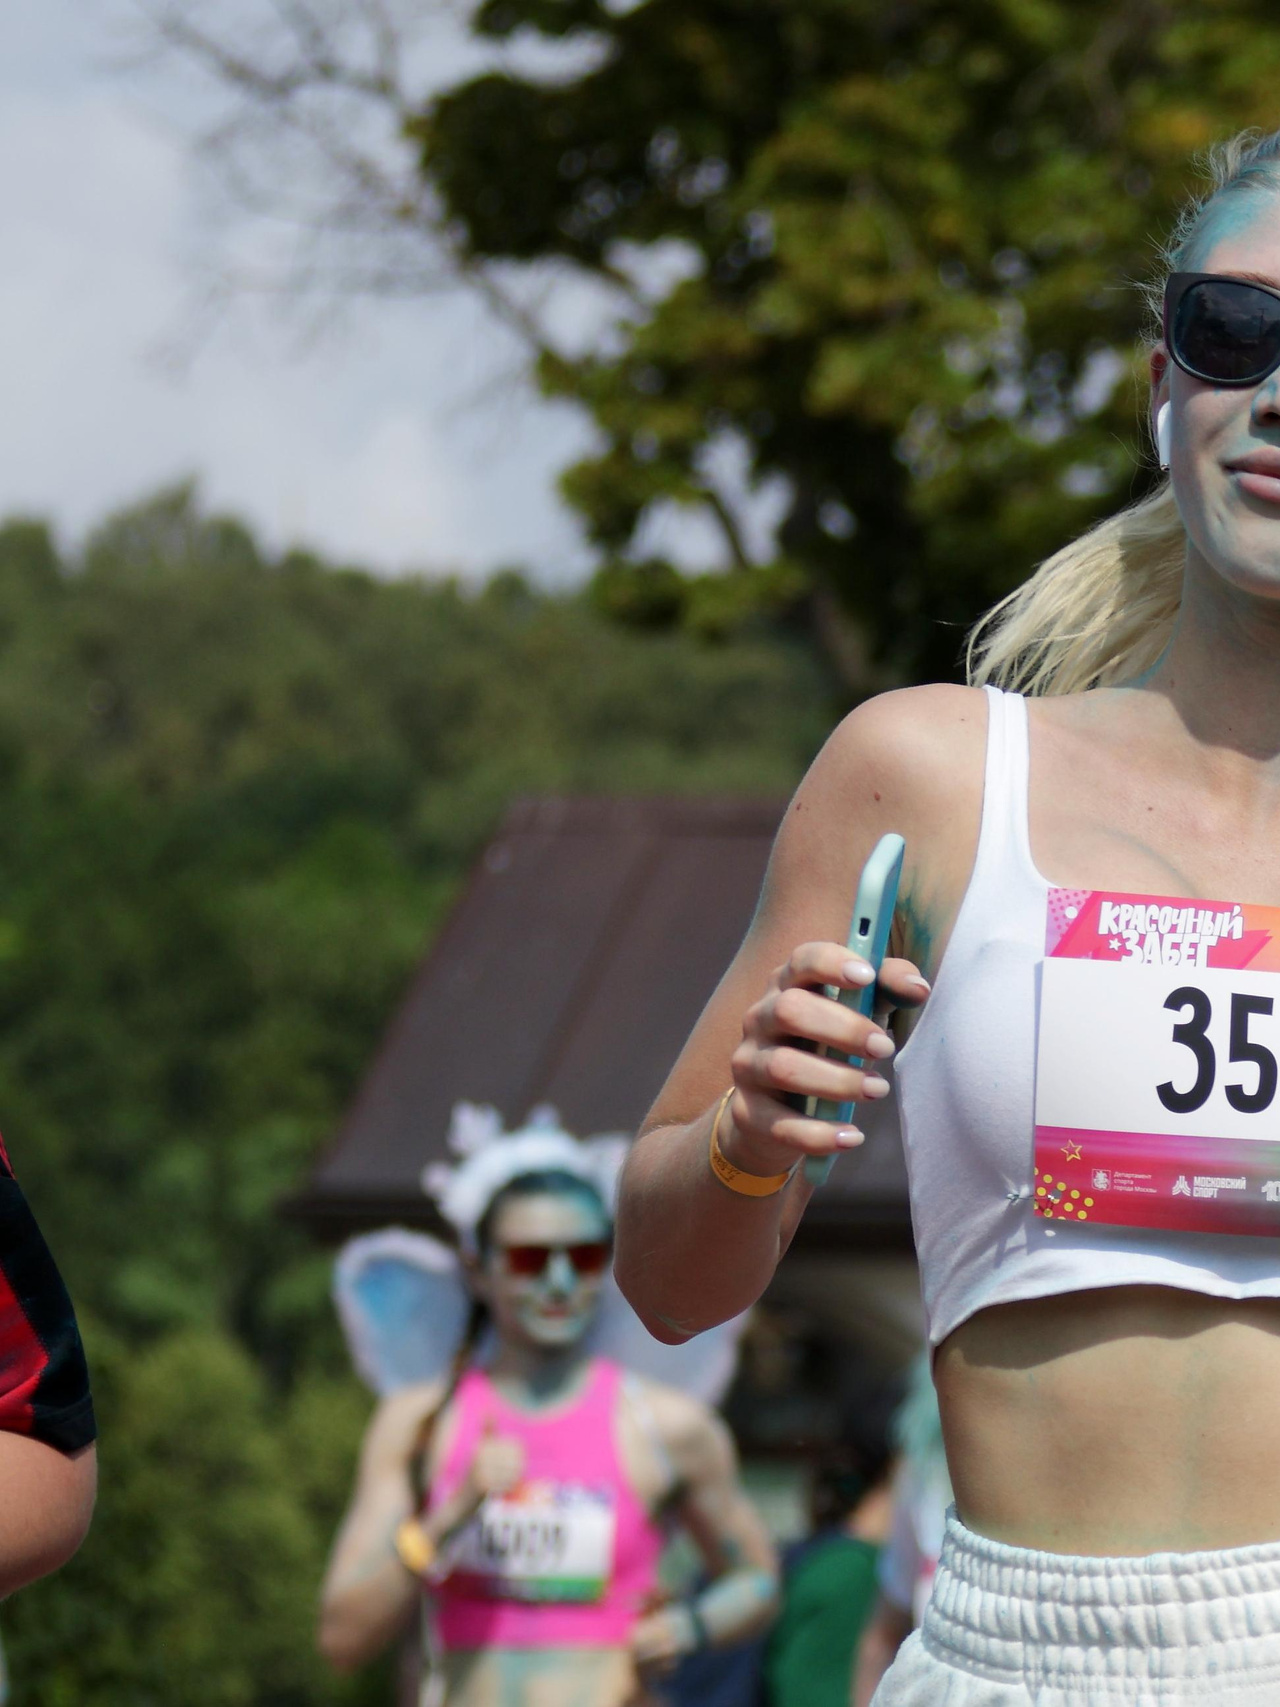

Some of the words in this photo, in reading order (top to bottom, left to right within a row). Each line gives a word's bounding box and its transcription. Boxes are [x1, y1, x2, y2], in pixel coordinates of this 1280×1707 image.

[1098, 901, 1244, 940] КРАСОЧНЫЙ
[1120, 929, 1219, 968] ЗАБЕГ
[1193, 1176, 1247, 1190] МОСКОВСКИЙ
[1193, 1187, 1218, 1199] СПОРТ
